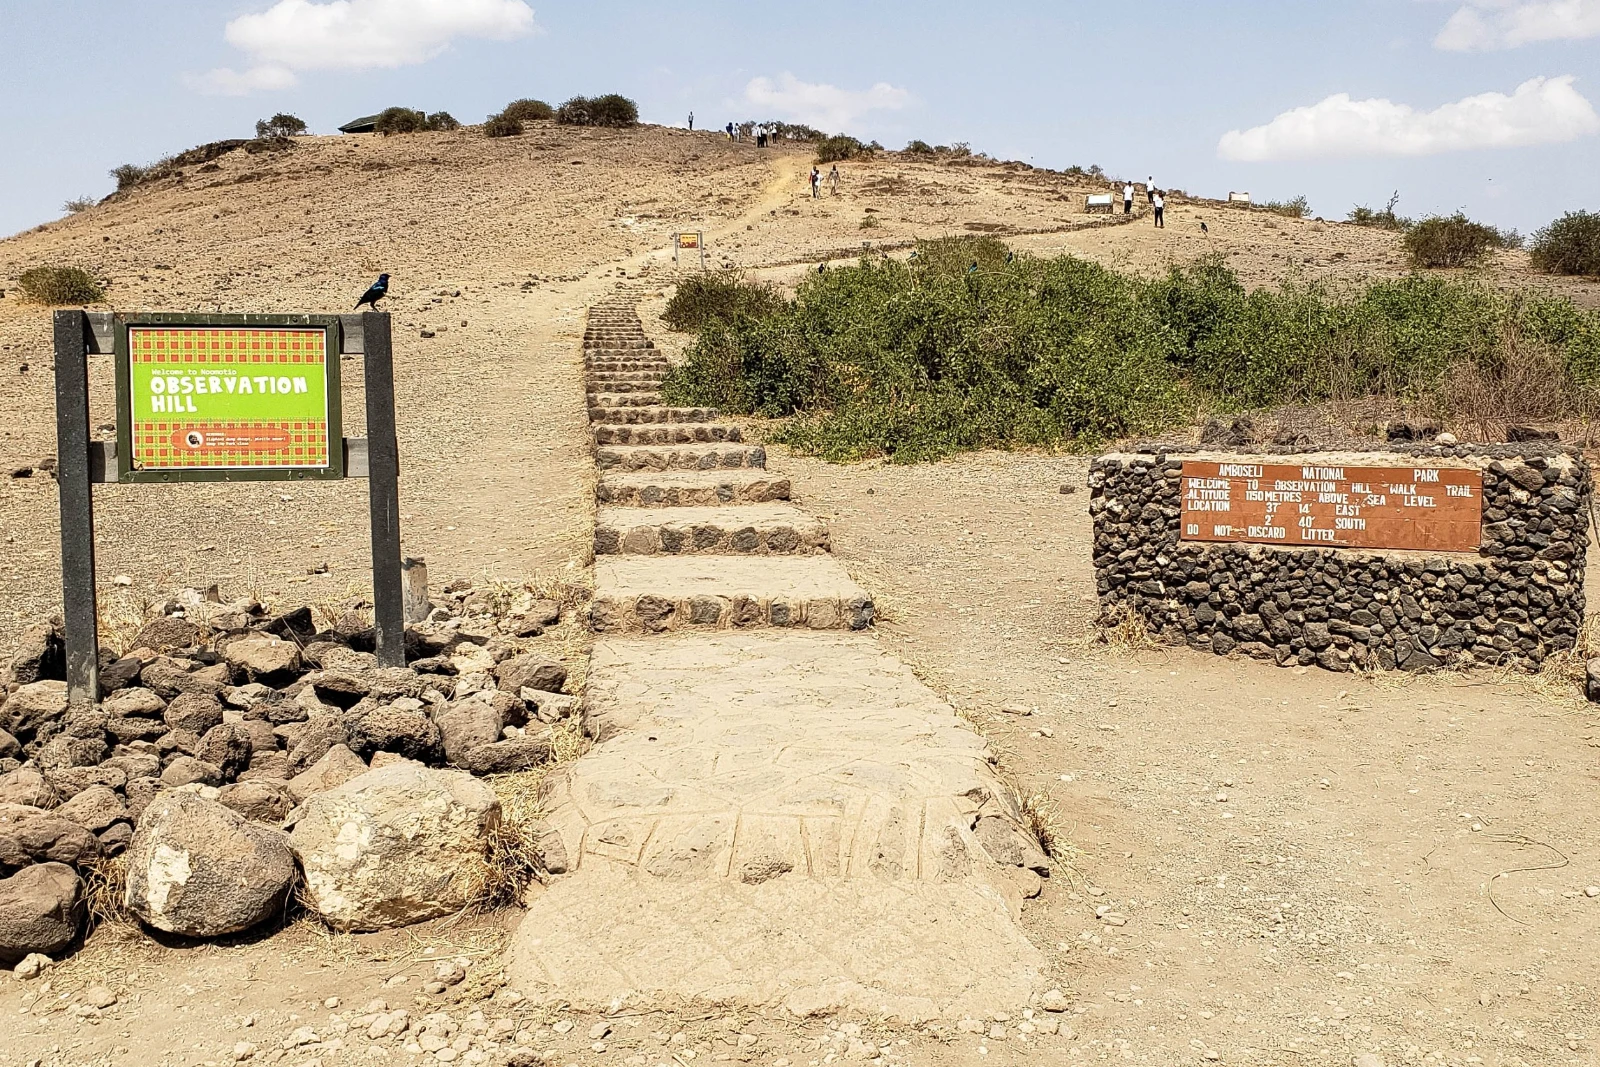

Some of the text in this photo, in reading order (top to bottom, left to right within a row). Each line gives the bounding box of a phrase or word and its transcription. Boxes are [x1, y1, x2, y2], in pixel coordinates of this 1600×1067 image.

[150, 376, 308, 394] OBSERVATION
[151, 395, 197, 413] HILL
[1219, 464, 1439, 482] AMBOSELI NATIONAL PARK
[1188, 478, 1474, 498] WELCOME TO OBSERVATION HILL WALK TRAIL
[1188, 490, 1230, 500] ALTITUDE
[1264, 492, 1302, 503] METRES
[1318, 493, 1349, 504] ABOVE
[1367, 495, 1386, 506] SEA
[1404, 496, 1436, 507] LEVEL
[1188, 500, 1230, 511] LOCATION
[1336, 504, 1360, 516] EAST
[1187, 524, 1335, 540] DO NOT DISCARD LITTER
[1335, 518, 1366, 530] SOUTH
